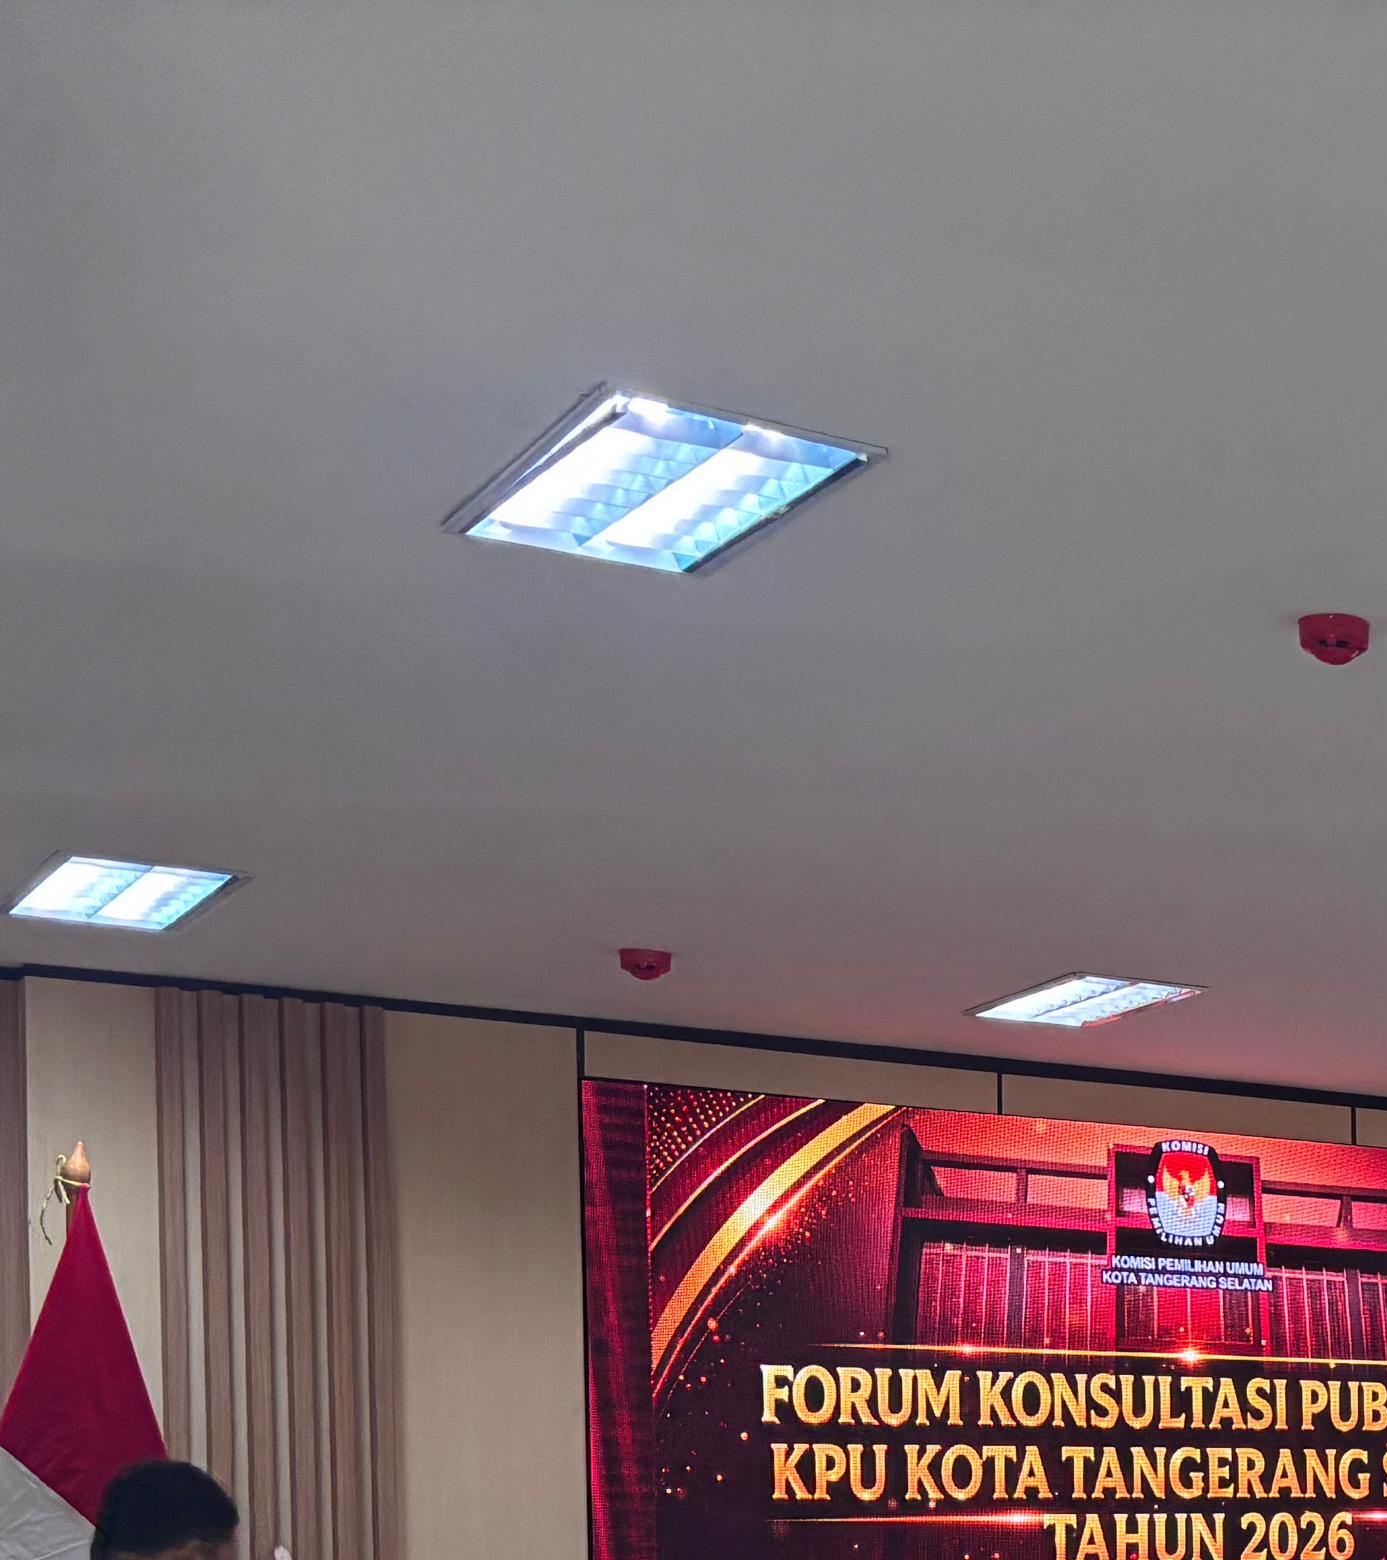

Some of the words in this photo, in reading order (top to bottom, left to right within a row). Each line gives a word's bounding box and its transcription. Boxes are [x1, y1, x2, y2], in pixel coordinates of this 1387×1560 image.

[1162, 1141, 1209, 1155] KOMISI
[1147, 1198, 1203, 1246] PEMILIHAN
[1102, 1271, 1137, 1285] KOTA
[1139, 1273, 1221, 1288] TANGERANG
[1219, 1277, 1273, 1292] SELATAN
[1112, 1255, 1156, 1270] KOMISI
[1158, 1258, 1223, 1274] PEMILIHAN
[1226, 1262, 1264, 1276] UMUM
[759, 1364, 965, 1428] FORUM
[976, 1369, 1289, 1432] KONSULTASI
[770, 1442, 888, 1501] KPU
[904, 1443, 1055, 1502] KOTA
[1061, 1445, 1371, 1500] TANGERANG
